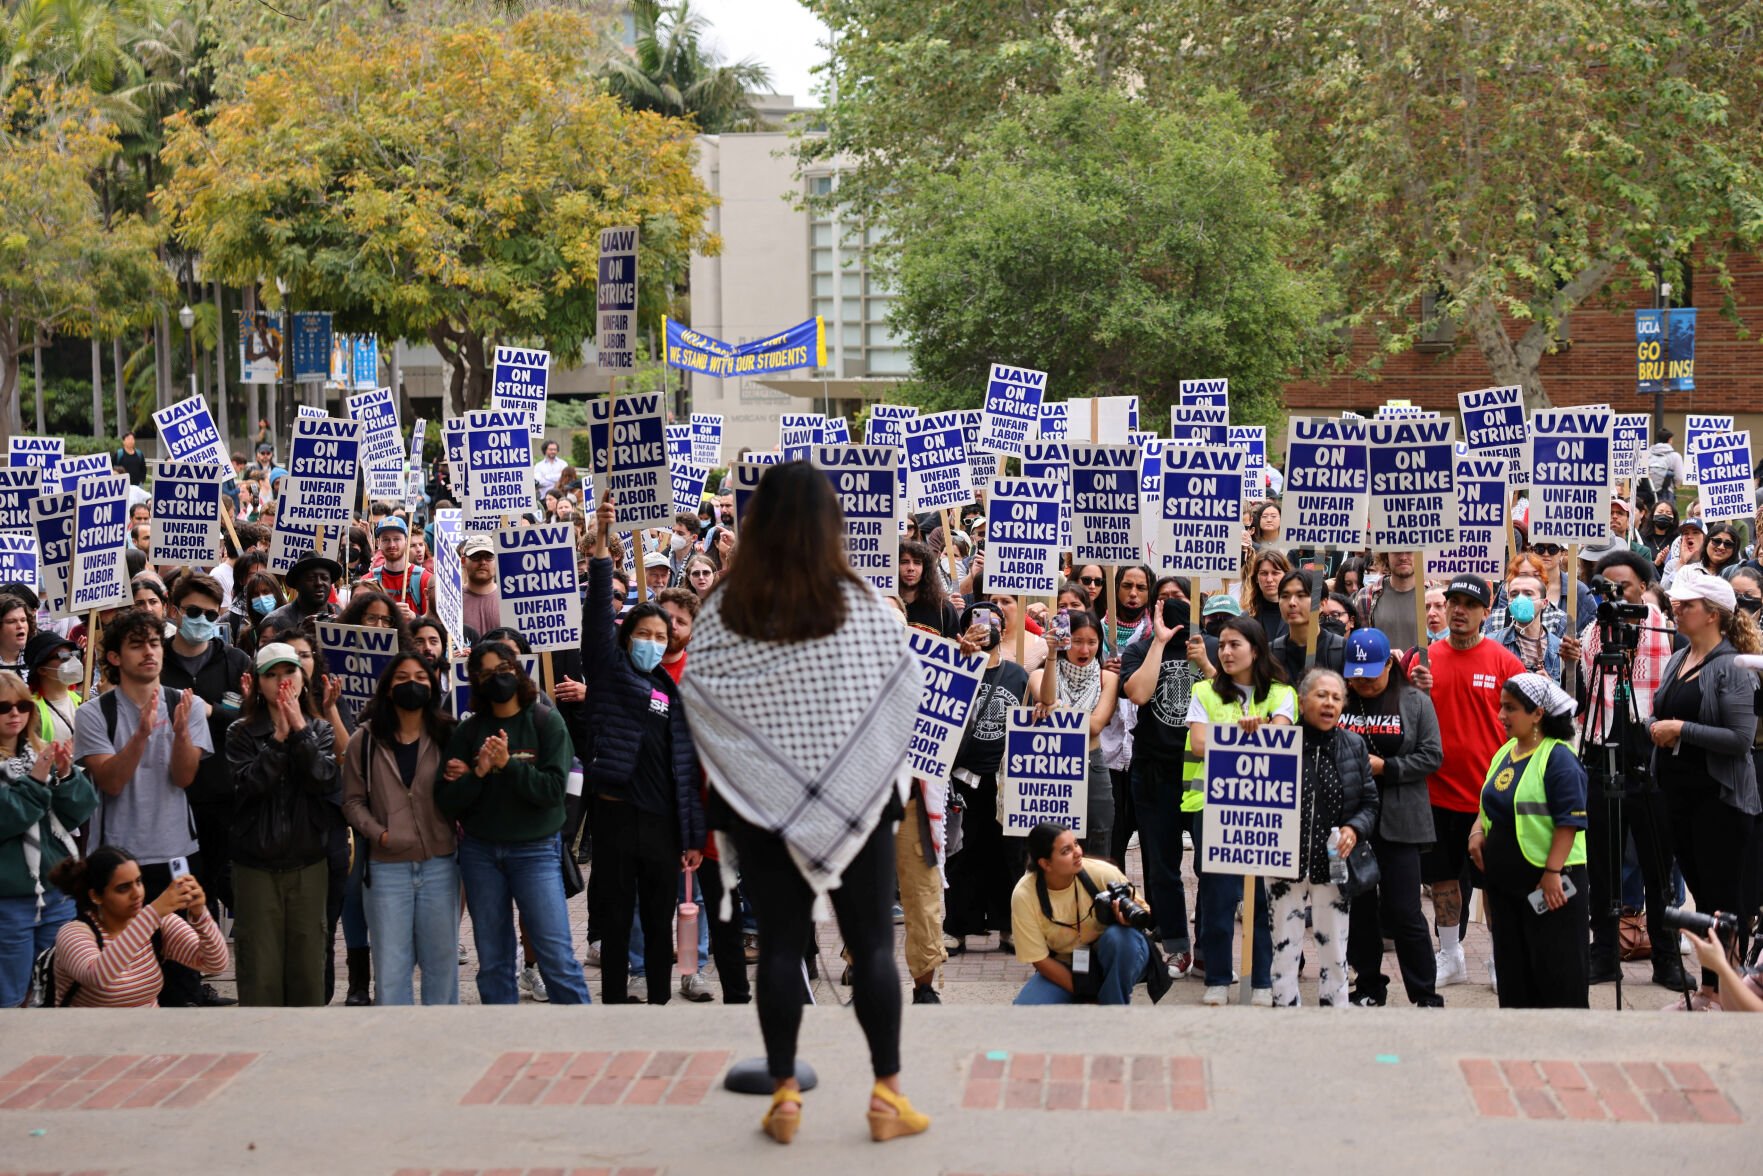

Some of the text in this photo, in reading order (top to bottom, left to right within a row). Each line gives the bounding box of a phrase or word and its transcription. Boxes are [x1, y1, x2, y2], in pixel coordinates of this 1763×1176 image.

[602, 231, 634, 252] UAW
[609, 259, 623, 279] ON
[600, 283, 633, 304] STRIKE
[602, 315, 628, 330] UNFAIR
[1638, 321, 1660, 333] UCLA
[603, 334, 626, 349] LABOR
[497, 349, 547, 366] UAW
[1638, 341, 1660, 360] GO
[599, 352, 632, 367] PRACTICE
[670, 346, 681, 363] WE
[682, 349, 708, 370] STAND
[736, 354, 755, 372] OUR
[758, 346, 807, 369] STUDENTS
[511, 369, 530, 382] ON
[994, 367, 1043, 386] UAW
[497, 382, 544, 398] STRIKE
[1006, 385, 1026, 400] ON
[1183, 382, 1226, 394] UAW
[351, 390, 388, 408] UAW
[501, 399, 538, 411] UNFAIR
[1464, 388, 1519, 409] UAW
[158, 397, 202, 425] UAW
[365, 406, 381, 418] ON
[592, 395, 659, 420] UAW
[874, 407, 915, 418] UAW
[988, 397, 1038, 417] STRIKE
[470, 412, 525, 428] UAW
[692, 415, 722, 425] UAW
[782, 416, 823, 426] UAW
[905, 413, 958, 434] UAW
[1176, 409, 1226, 423] UAW
[1483, 410, 1506, 427] ON
[1535, 414, 1610, 434] UAW
[1689, 418, 1731, 429] UAW
[178, 419, 196, 436] ON
[299, 421, 358, 437] UAW
[614, 422, 641, 443] ON
[700, 426, 712, 434] ON
[991, 417, 1028, 432] UNFAIR
[1296, 421, 1366, 440] UAW
[172, 427, 216, 456] STRIKE
[488, 432, 511, 448] ON
[784, 430, 811, 445] UAW
[923, 433, 946, 450] ON
[991, 428, 1025, 441] LABOR
[1191, 427, 1211, 441] ON
[1369, 423, 1451, 445] UAW
[1469, 424, 1524, 445] STRIKE
[1620, 430, 1635, 439] ON
[1698, 434, 1746, 450] UAW
[13, 439, 60, 450] UAW
[314, 442, 338, 457] ON
[368, 440, 394, 453] LABOR
[1556, 441, 1584, 460] ON
[26, 455, 46, 467] ON
[472, 448, 528, 465] STRIKE
[820, 448, 892, 466] UAW
[911, 447, 964, 468] STRIKE
[1072, 449, 1136, 467] UAW
[1166, 450, 1241, 471] UAW
[1315, 447, 1346, 466] ON
[1395, 450, 1426, 469] ON
[1713, 451, 1733, 465] ON
[61, 456, 107, 474] UAW
[159, 465, 217, 479] UAW
[294, 458, 354, 475] STRIKE
[1536, 462, 1606, 483] STRIKE
[1701, 464, 1749, 481] STRIKE
[481, 471, 523, 484] UNFAIR
[840, 473, 869, 491] ON
[920, 467, 961, 483] UNFAIR
[1093, 473, 1117, 491] ON
[1290, 467, 1365, 488] STRIKE
[1374, 469, 1451, 491] STRIKE
[82, 479, 125, 500] UAW
[175, 484, 199, 499] ON
[300, 481, 345, 493] UNFAIR
[484, 484, 522, 497] LABOR
[673, 478, 690, 491] ON
[924, 479, 961, 495] LABOR
[994, 481, 1059, 498] UAW
[1188, 477, 1217, 496] ON
[1708, 483, 1745, 496] UNFAIR
[301, 494, 341, 507] LABOR
[475, 496, 532, 511] PRACTICE
[918, 490, 972, 508] PRACTICE
[1076, 492, 1137, 511] STRIKE
[1297, 496, 1354, 511] UNFAIR
[1383, 496, 1443, 512] UNFAIR
[1543, 489, 1597, 503] UNFAIR
[1711, 494, 1744, 506] LABOR
[93, 505, 112, 524] ON
[156, 501, 216, 516] STRIKE
[290, 507, 349, 520] PRACTICE
[1011, 504, 1038, 521] ON
[1166, 498, 1238, 518] STRIKE
[1545, 505, 1594, 520] LABOR
[1705, 503, 1753, 518] PRACTICE
[1084, 516, 1131, 530] UNFAIR
[1300, 512, 1350, 527] LABOR
[1387, 513, 1441, 529] LABOR
[79, 523, 124, 547] STRIKE
[162, 523, 208, 534] UNFAIR
[992, 521, 1056, 540] STRIKE
[1173, 523, 1229, 538] UNFAIR
[1285, 528, 1361, 544] PRACTICE
[1533, 521, 1606, 537] PRACTICE
[165, 535, 205, 547] LABOR
[500, 527, 569, 548] UAW
[1086, 531, 1129, 544] LABOR
[1375, 529, 1454, 545] PRACTICE
[154, 547, 214, 560] PRACTICE
[998, 546, 1047, 560] UNFAIR
[1077, 546, 1140, 560] PRACTICE
[1175, 540, 1226, 554] LABOR
[84, 552, 116, 570] UNFAIR
[522, 551, 550, 571] ON
[1000, 561, 1044, 575] LABOR
[1162, 556, 1237, 572] PRACTICE
[1427, 560, 1500, 574] PRACTICE
[84, 570, 113, 586] LABOR
[503, 570, 573, 593] STRIKE
[988, 575, 1054, 590] PRACTICE
[75, 583, 120, 604] PRACTICE
[514, 598, 567, 615] UNFAIR
[518, 614, 566, 631] LABOR
[320, 627, 393, 651] UAW
[1356, 645, 1367, 660] LA
[345, 655, 372, 674] ON
[650, 699, 669, 712] SF
[1013, 709, 1084, 729] UAW
[1032, 734, 1061, 754] ON
[1214, 726, 1296, 749] UAW
[1010, 754, 1083, 776] STRIKE
[1236, 755, 1270, 777] ON
[1019, 782, 1072, 797] UNFAIR
[1211, 778, 1294, 804] STRIKE
[1021, 799, 1069, 813] LABOR
[1220, 810, 1283, 829] UNFAIR
[1223, 829, 1279, 847] LABOR
[1209, 847, 1292, 867] PRACTICE
